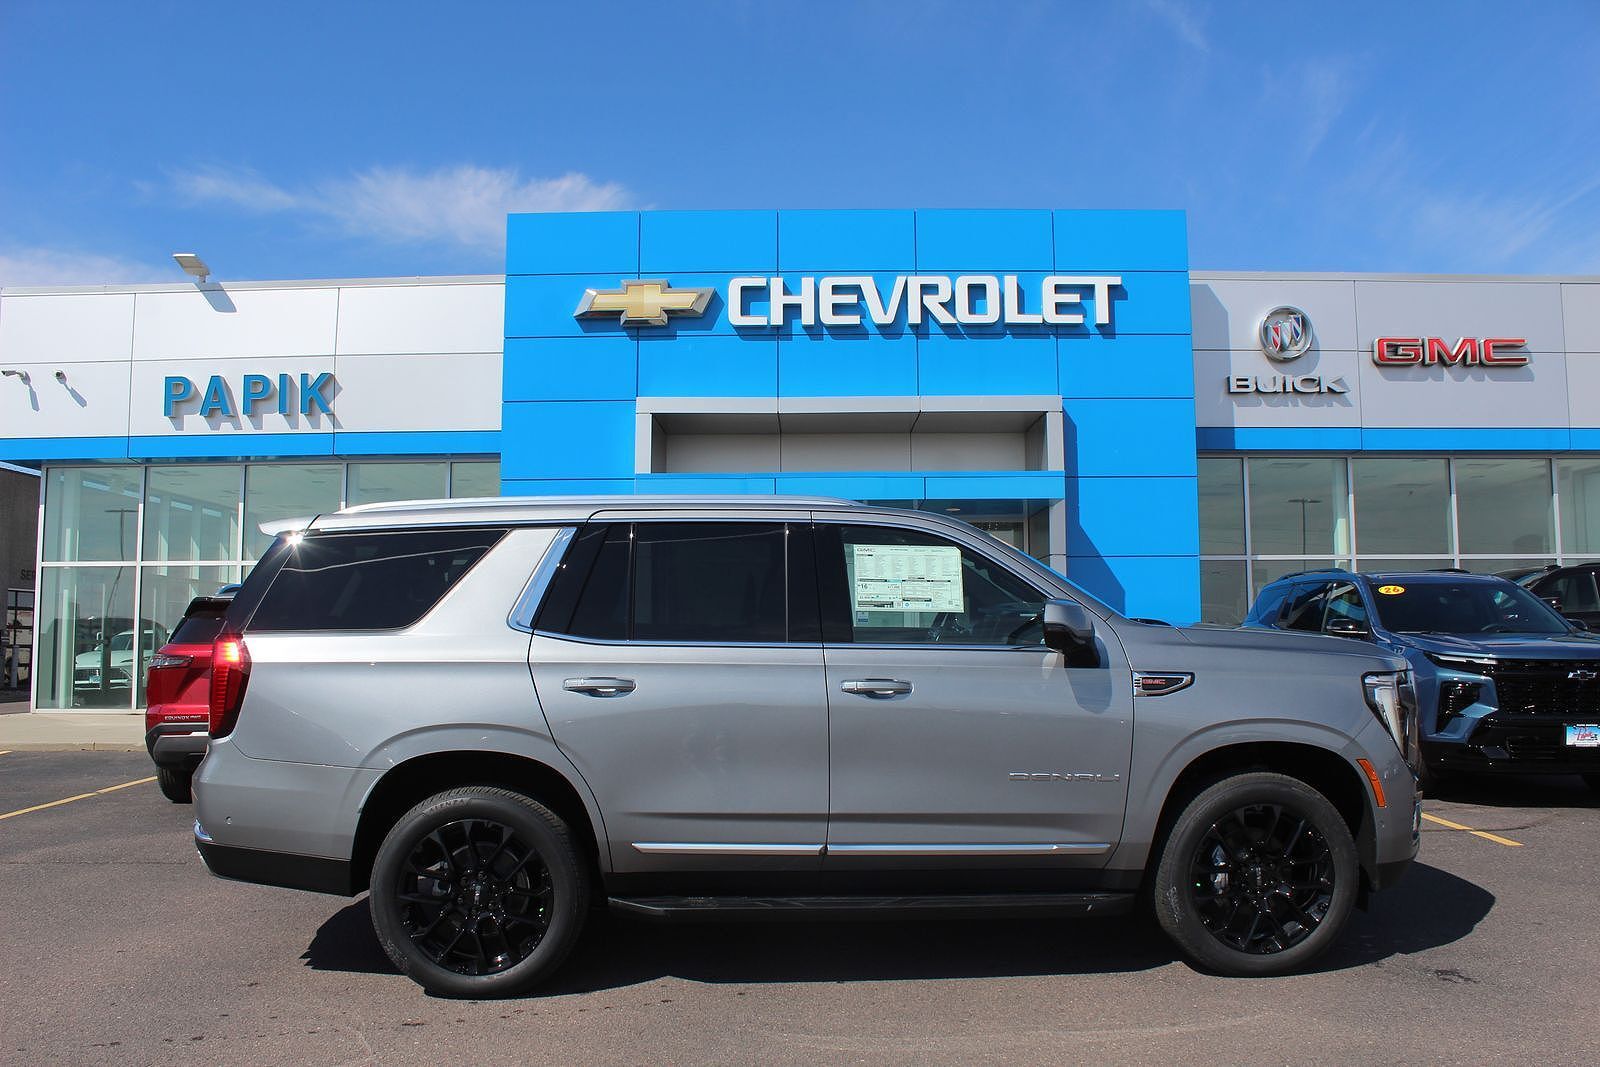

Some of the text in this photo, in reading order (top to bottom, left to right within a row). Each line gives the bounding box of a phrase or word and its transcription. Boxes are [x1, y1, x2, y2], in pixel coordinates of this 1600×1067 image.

[727, 275, 1122, 326] CHEVROLET
[1372, 337, 1529, 366] GMC
[163, 372, 336, 418] PAPIK
[1227, 375, 1349, 394] BUICK
[1384, 586, 1400, 594] 26
[1009, 772, 1120, 782] DENALI
